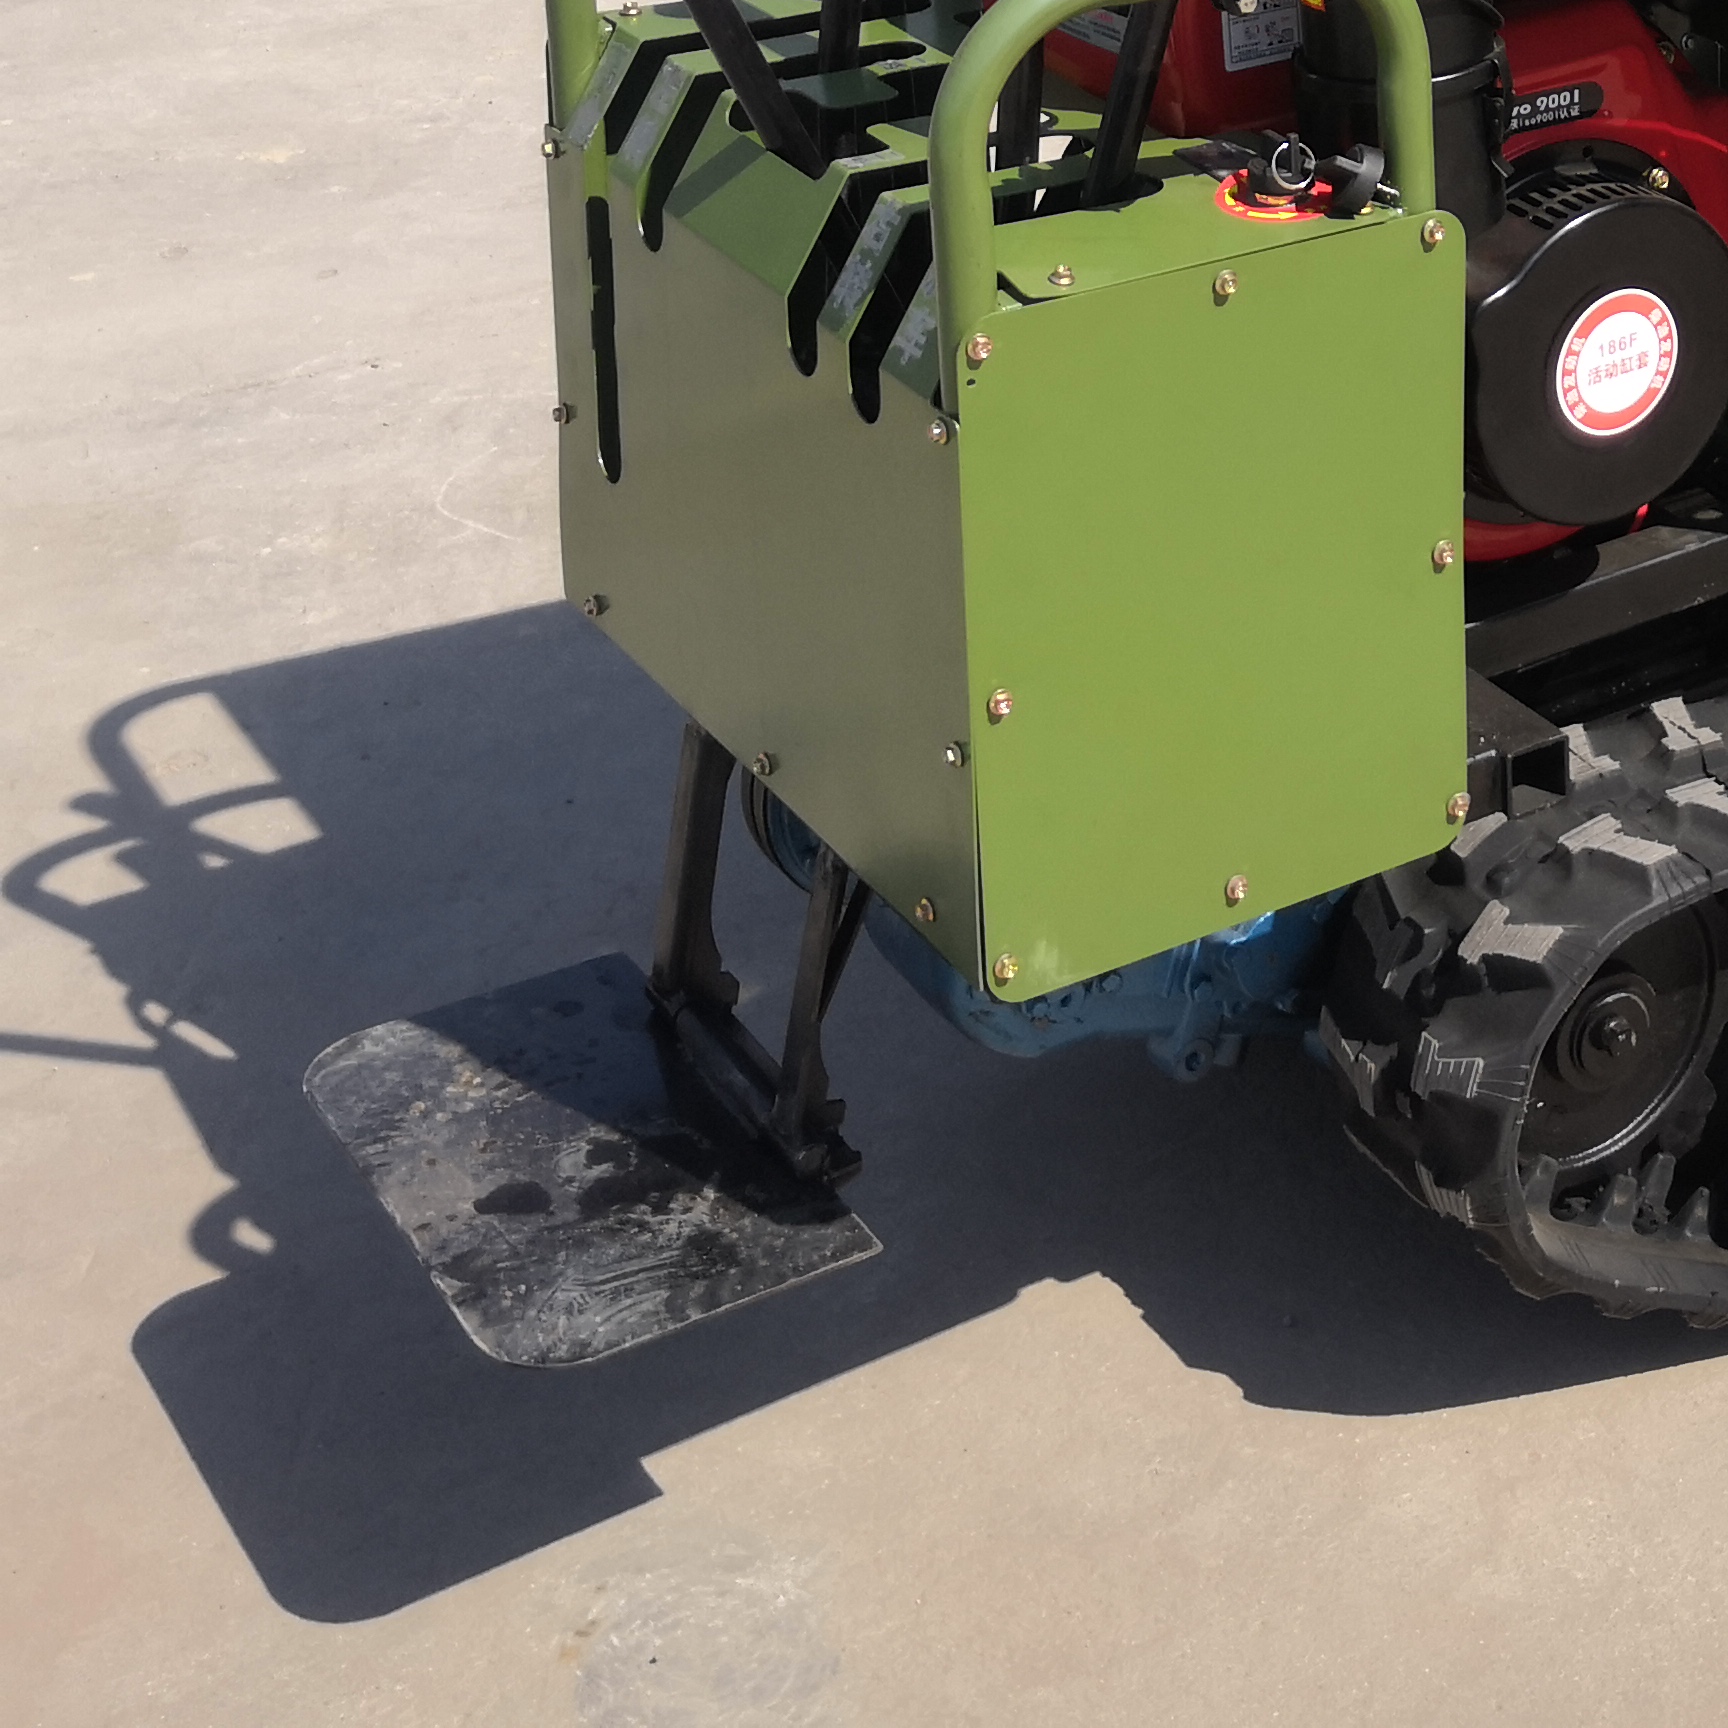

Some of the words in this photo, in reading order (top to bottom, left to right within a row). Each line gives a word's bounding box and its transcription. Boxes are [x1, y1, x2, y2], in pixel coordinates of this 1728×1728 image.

[1536, 89, 1580, 111] 9001
[1598, 332, 1638, 358] 186F
[1588, 350, 1650, 387] 活动缸套
